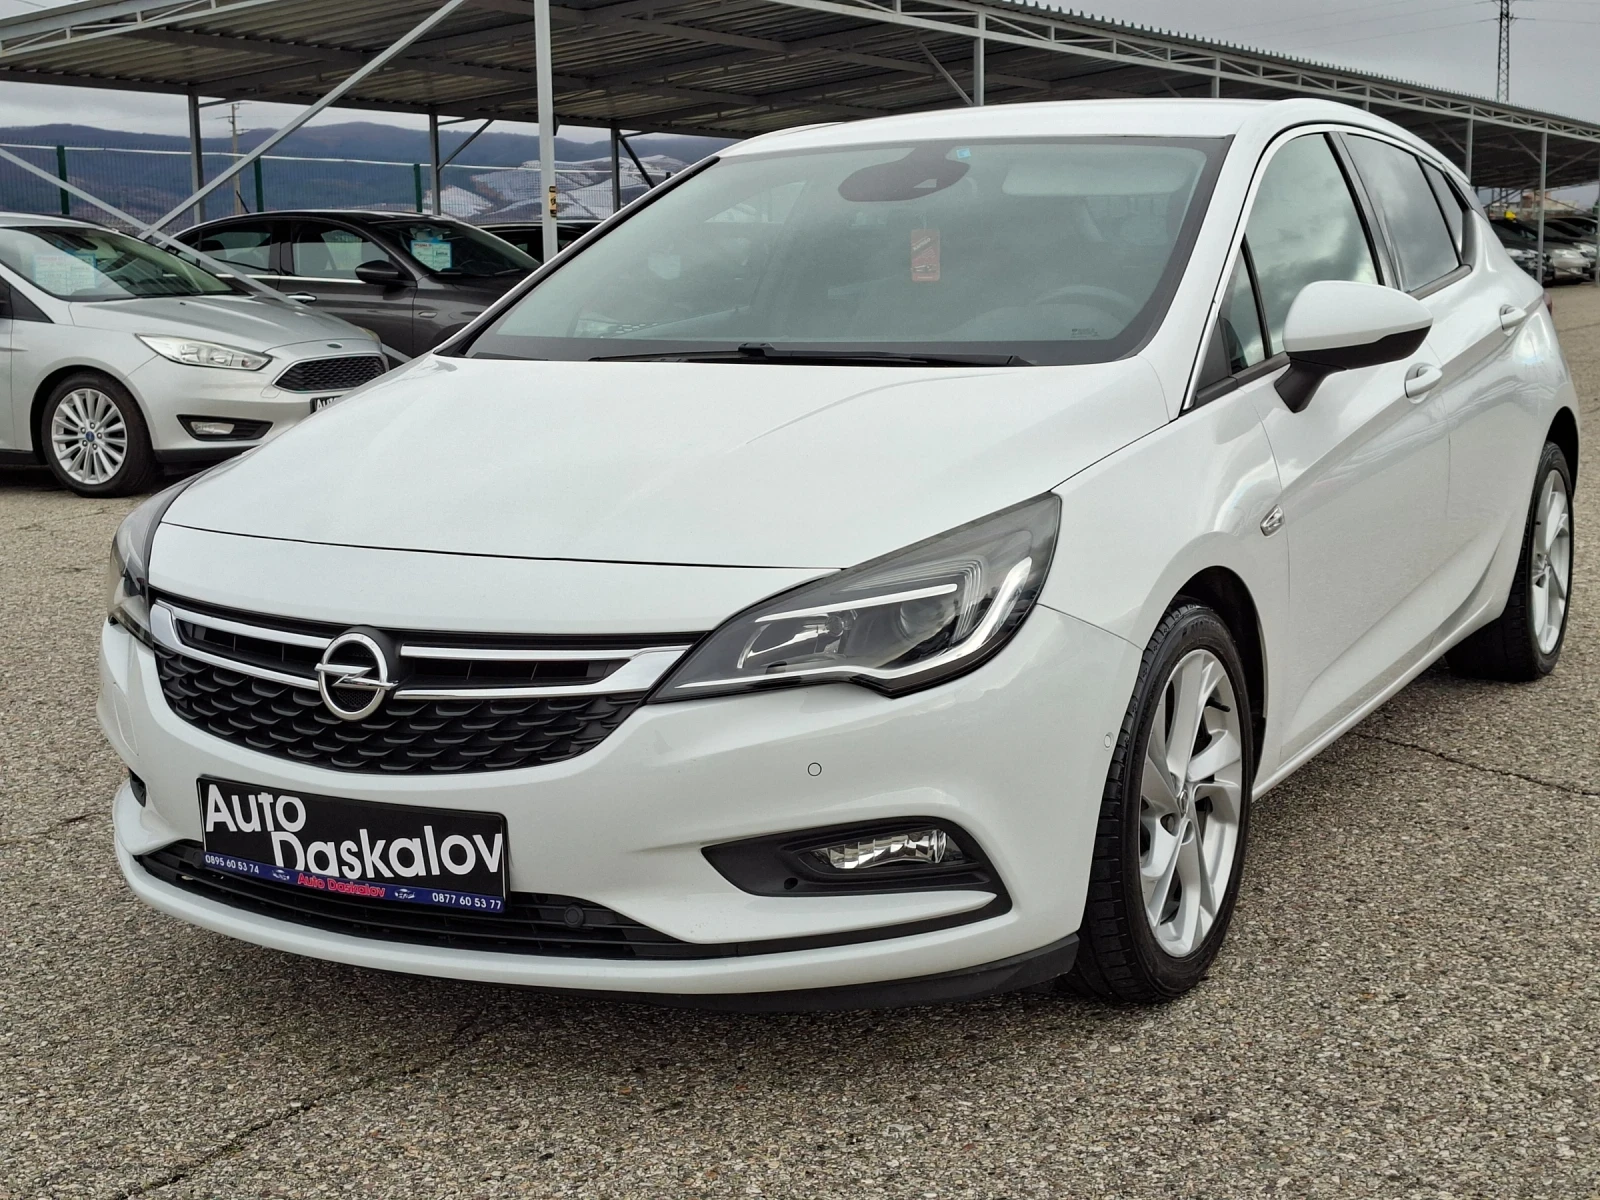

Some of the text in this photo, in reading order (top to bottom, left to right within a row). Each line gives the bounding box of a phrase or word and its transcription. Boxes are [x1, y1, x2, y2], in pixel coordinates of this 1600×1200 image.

[205, 784, 306, 832] Auto
[205, 854, 260, 874] 0895 60 53 74
[271, 826, 502, 879] Daskalov
[297, 872, 325, 889] Auto
[327, 878, 386, 898] Daskalov
[432, 892, 502, 911] 0877 60 53 77
